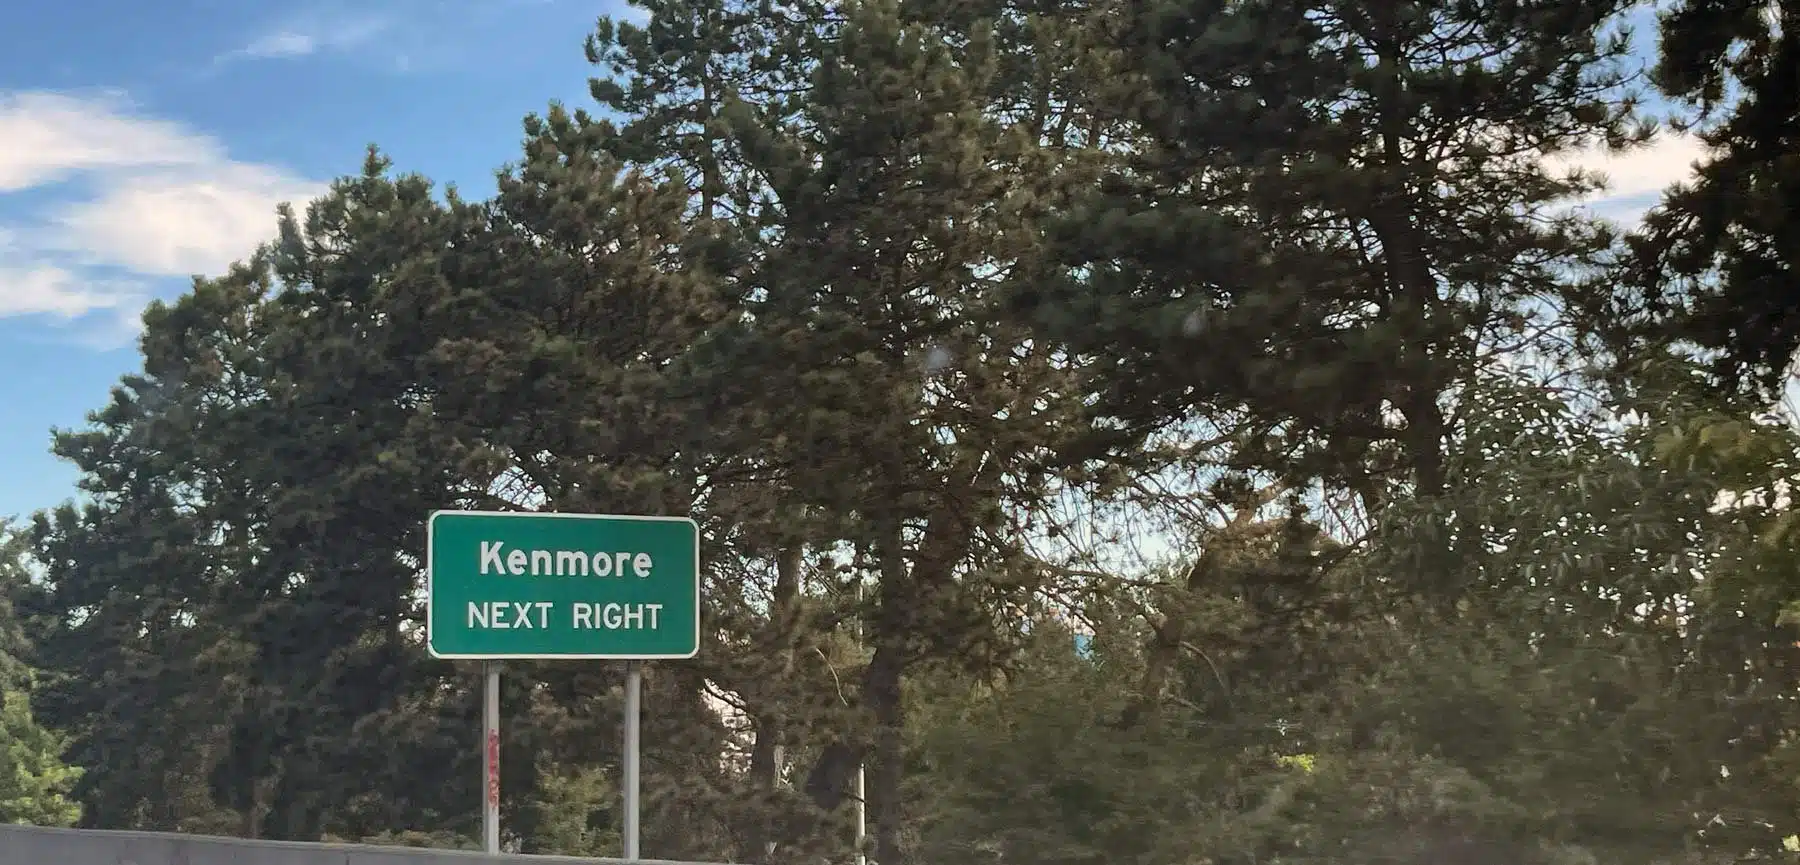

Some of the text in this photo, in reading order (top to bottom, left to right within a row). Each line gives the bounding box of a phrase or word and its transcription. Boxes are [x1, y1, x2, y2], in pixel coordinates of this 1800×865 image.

[479, 541, 653, 578] Kenmore
[467, 601, 664, 631] NEXT RIGHT
